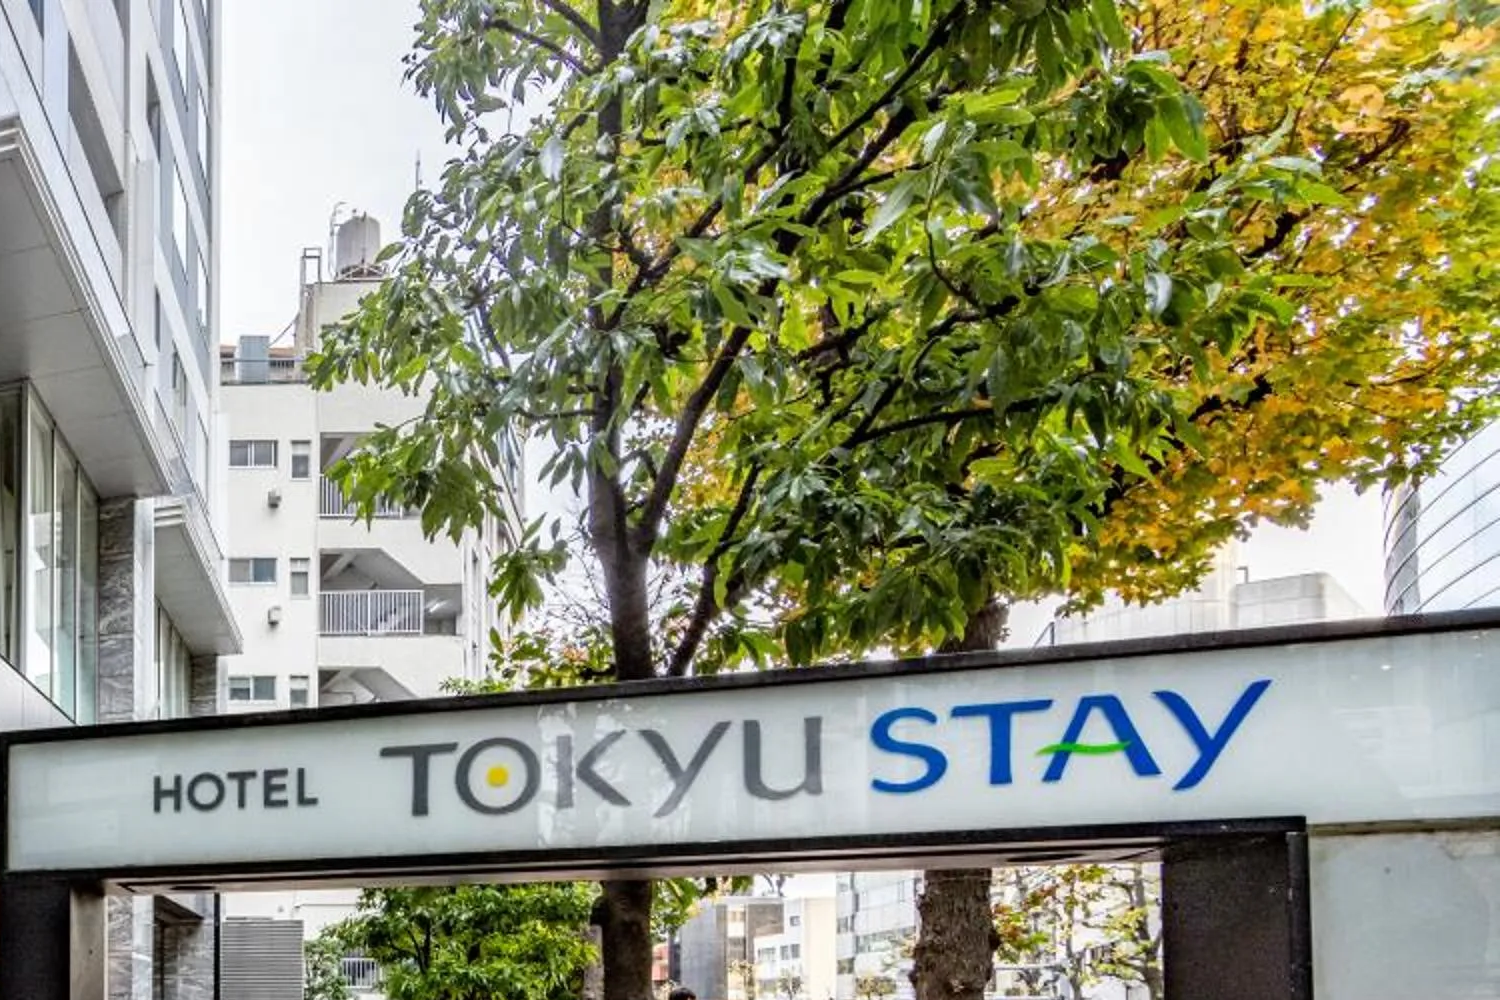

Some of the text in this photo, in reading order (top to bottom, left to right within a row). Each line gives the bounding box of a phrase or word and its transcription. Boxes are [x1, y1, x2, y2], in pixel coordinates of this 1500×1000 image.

[153, 679, 1273, 818] HOTEL TOKYU STAY
